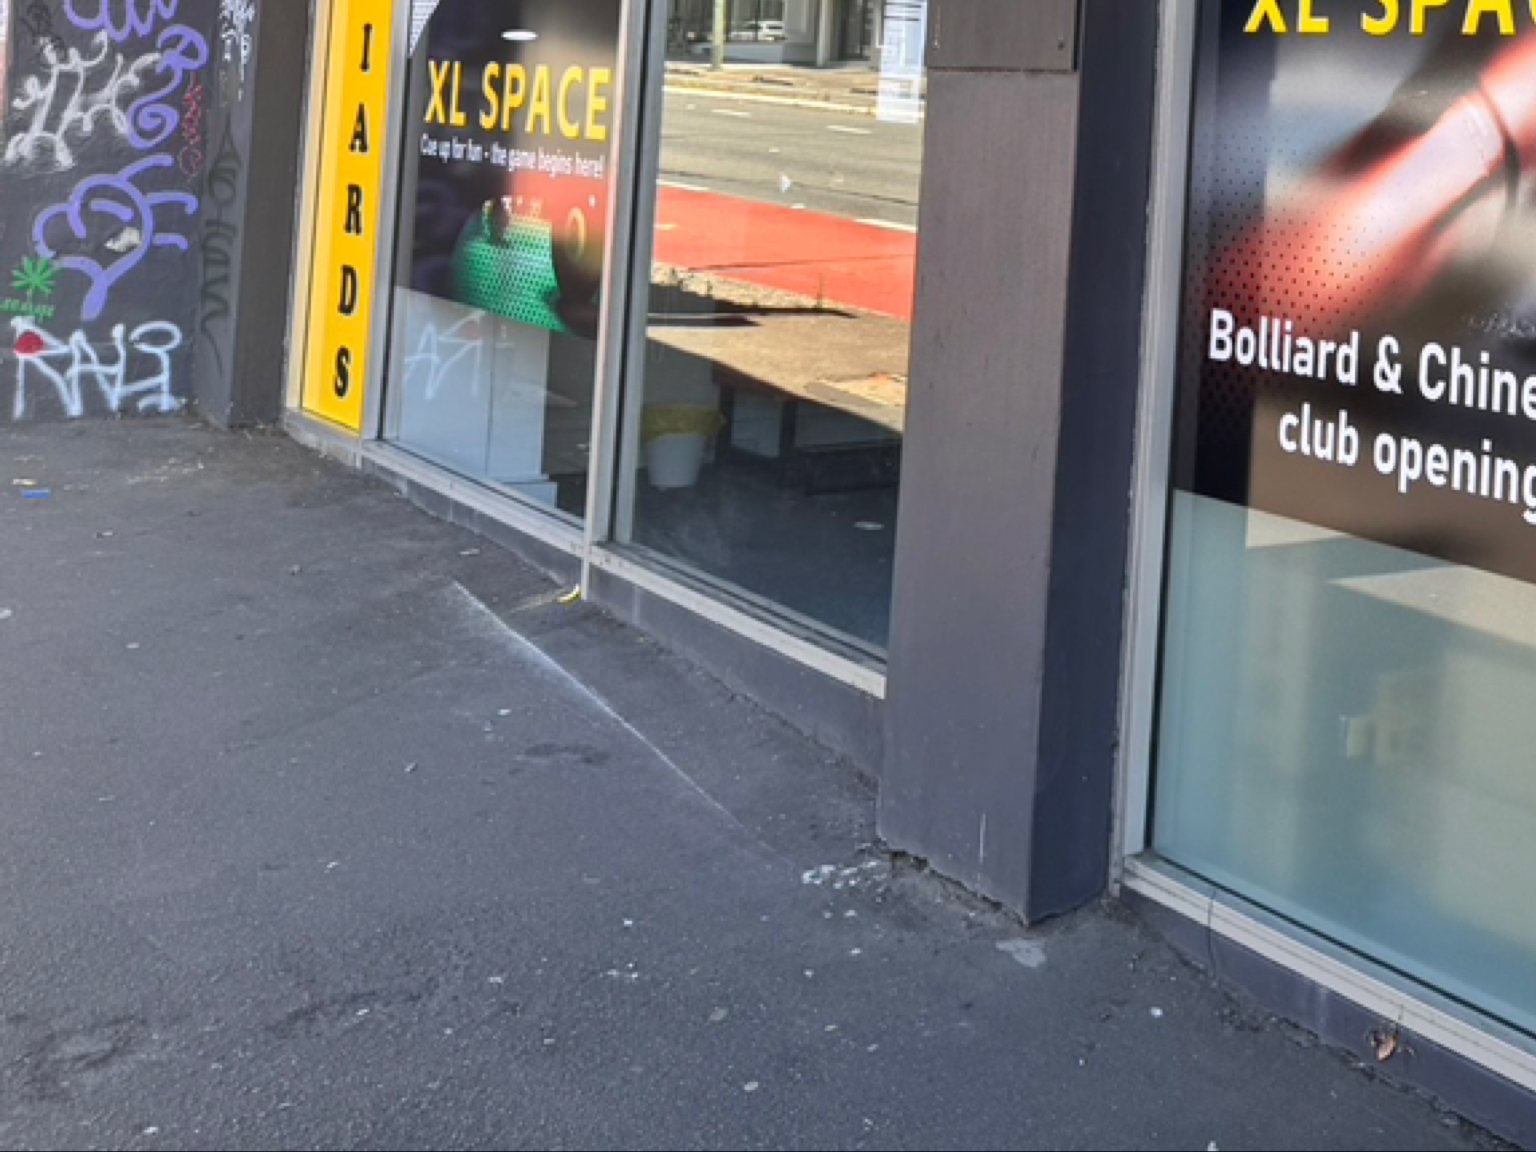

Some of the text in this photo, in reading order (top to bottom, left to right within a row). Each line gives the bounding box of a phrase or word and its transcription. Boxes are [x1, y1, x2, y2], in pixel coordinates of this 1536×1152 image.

[423, 60, 611, 140] XL SPACE
[1209, 308, 1359, 386] Bolliard
[1374, 336, 1403, 394] &
[1279, 402, 1359, 466] club
